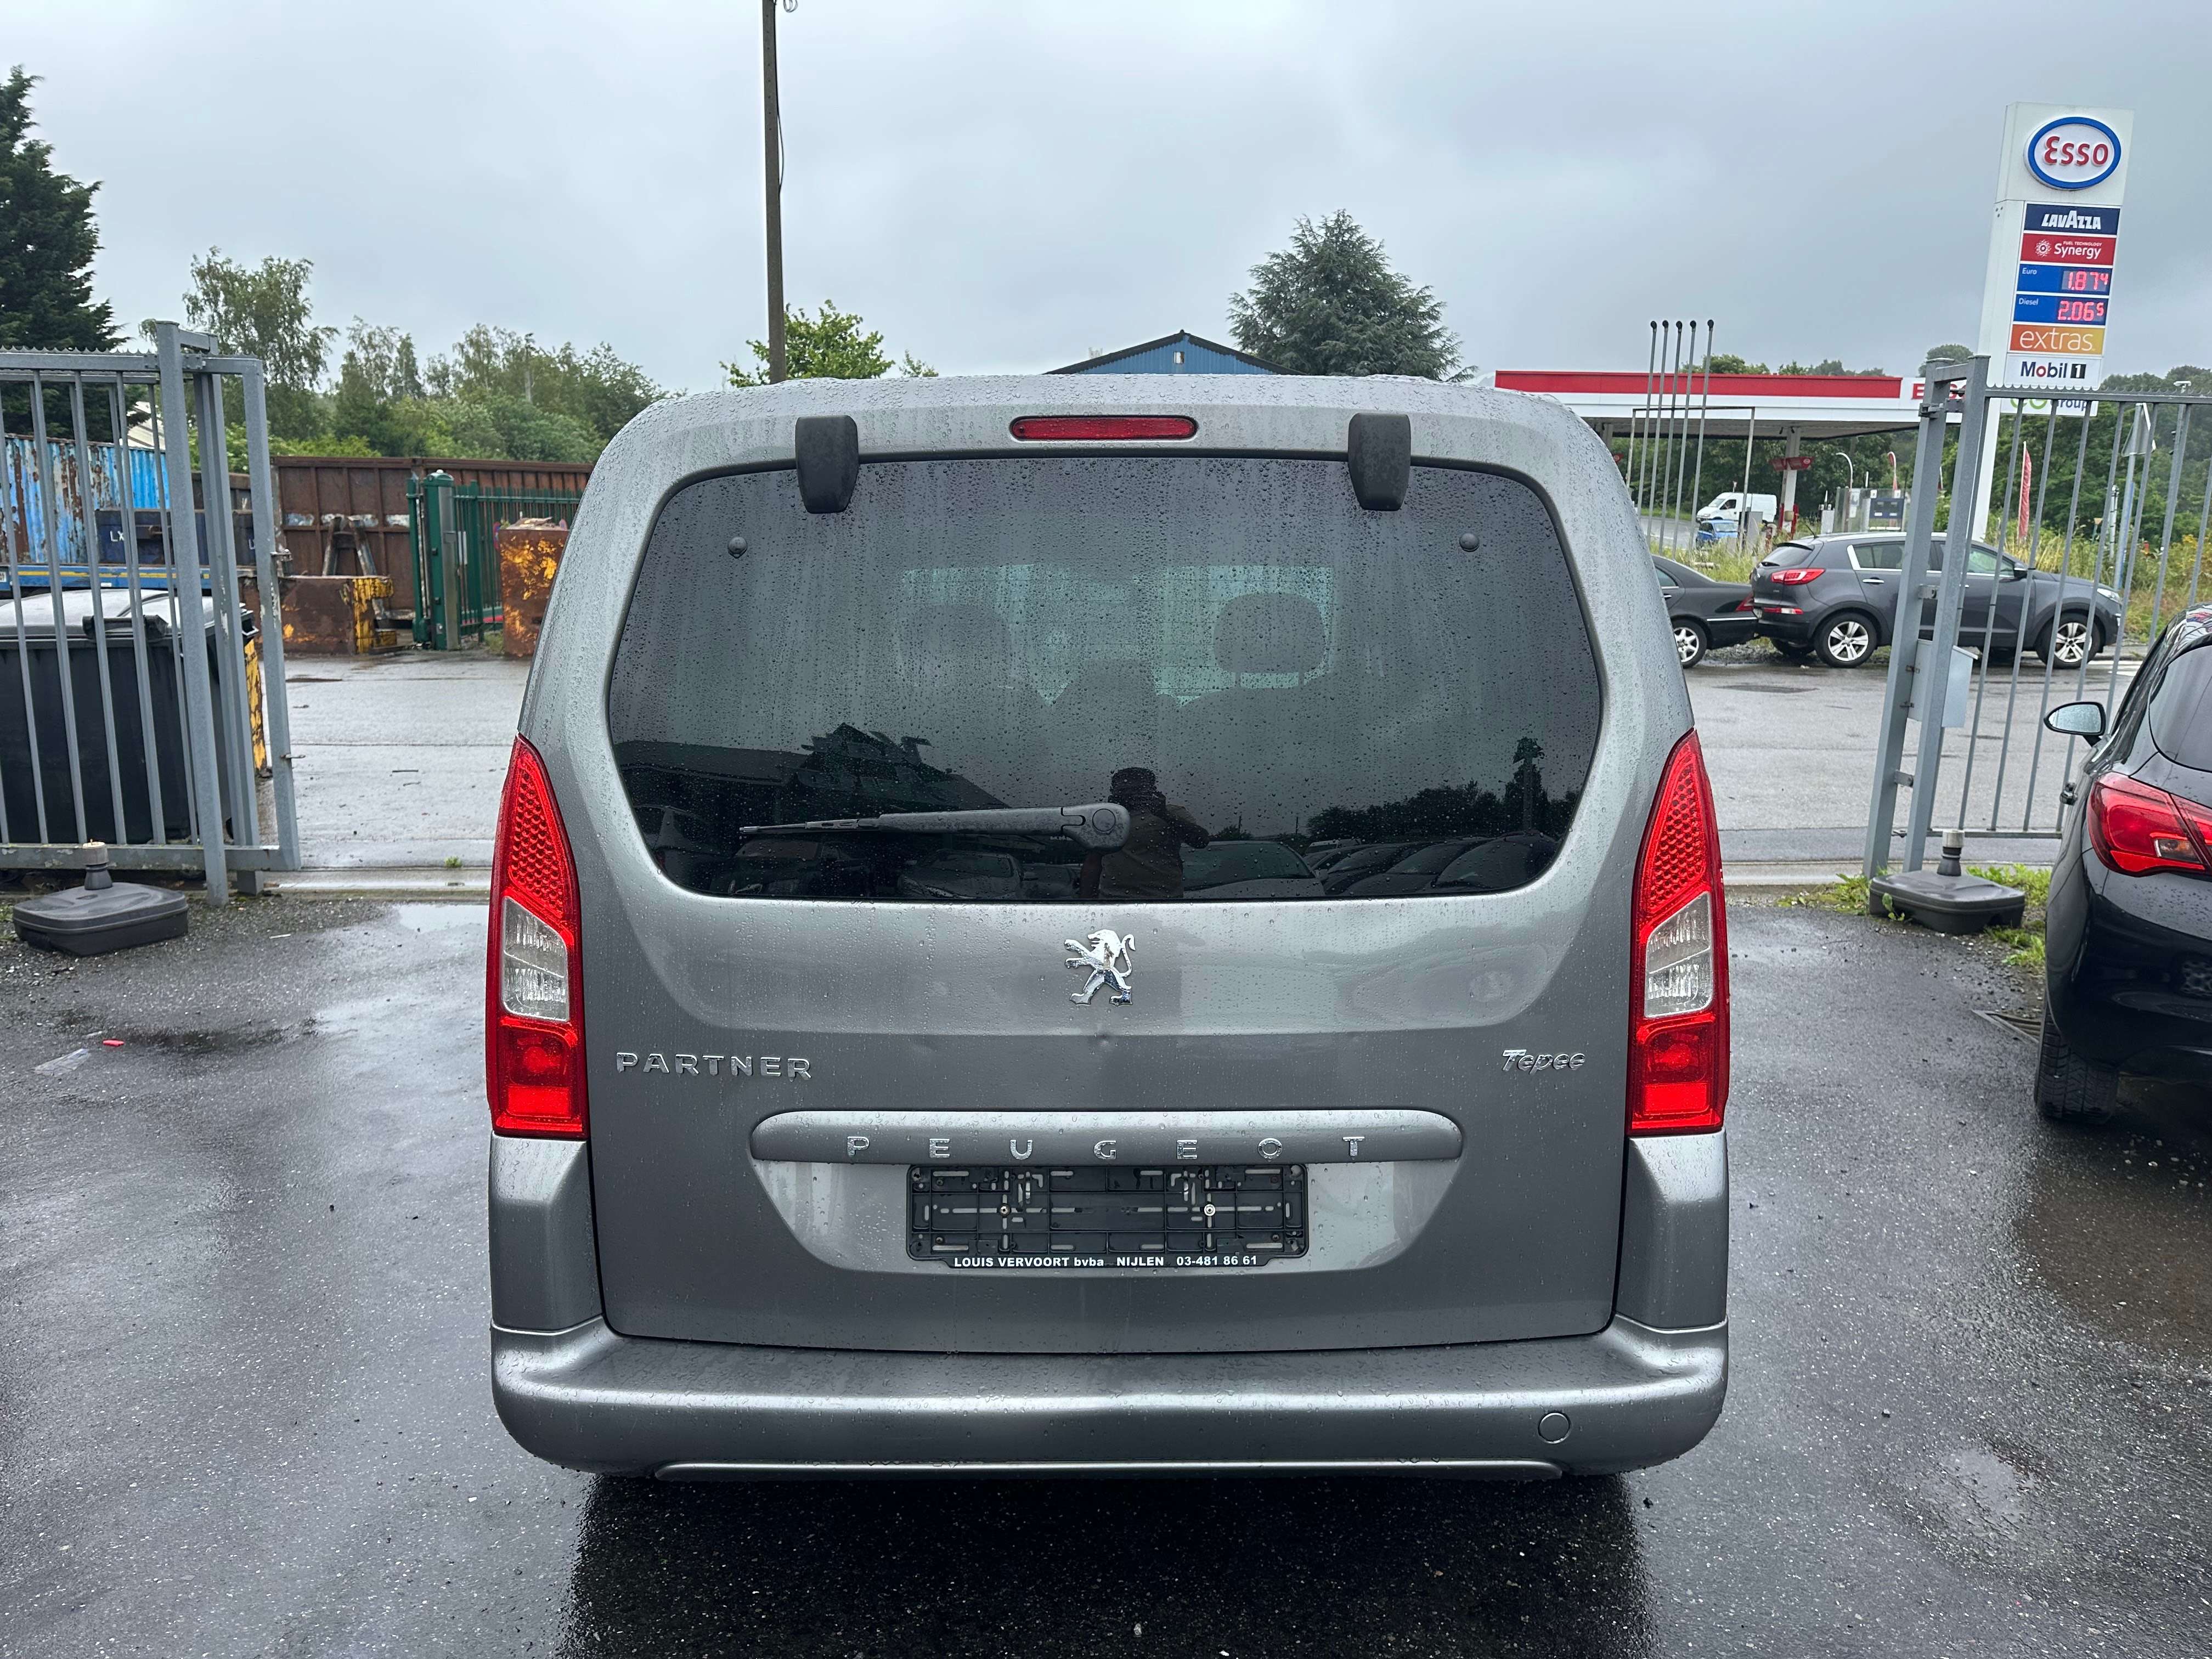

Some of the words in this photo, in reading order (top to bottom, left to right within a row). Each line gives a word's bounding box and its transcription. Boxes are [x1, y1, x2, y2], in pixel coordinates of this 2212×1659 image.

[2041, 210, 2102, 230] LAVAZZA
[2053, 242, 2102, 260] Synergy
[2018, 297, 2039, 306] Diesel
[2019, 327, 2094, 351] extras
[2020, 360, 2068, 379] Mobil
[616, 1052, 812, 1081] PARTNER
[1502, 1049, 1585, 1075] Tepee
[847, 1136, 1365, 1160] PEUGEOT
[953, 1257, 994, 1267] LOUIS
[997, 1257, 1070, 1267] VERVOORT
[1074, 1257, 1104, 1267] bvba
[1116, 1256, 1164, 1267] NIJLEN
[1176, 1256, 1218, 1266] 03-481
[1222, 1256, 1238, 1266] 86
[1242, 1255, 1257, 1266] 61
